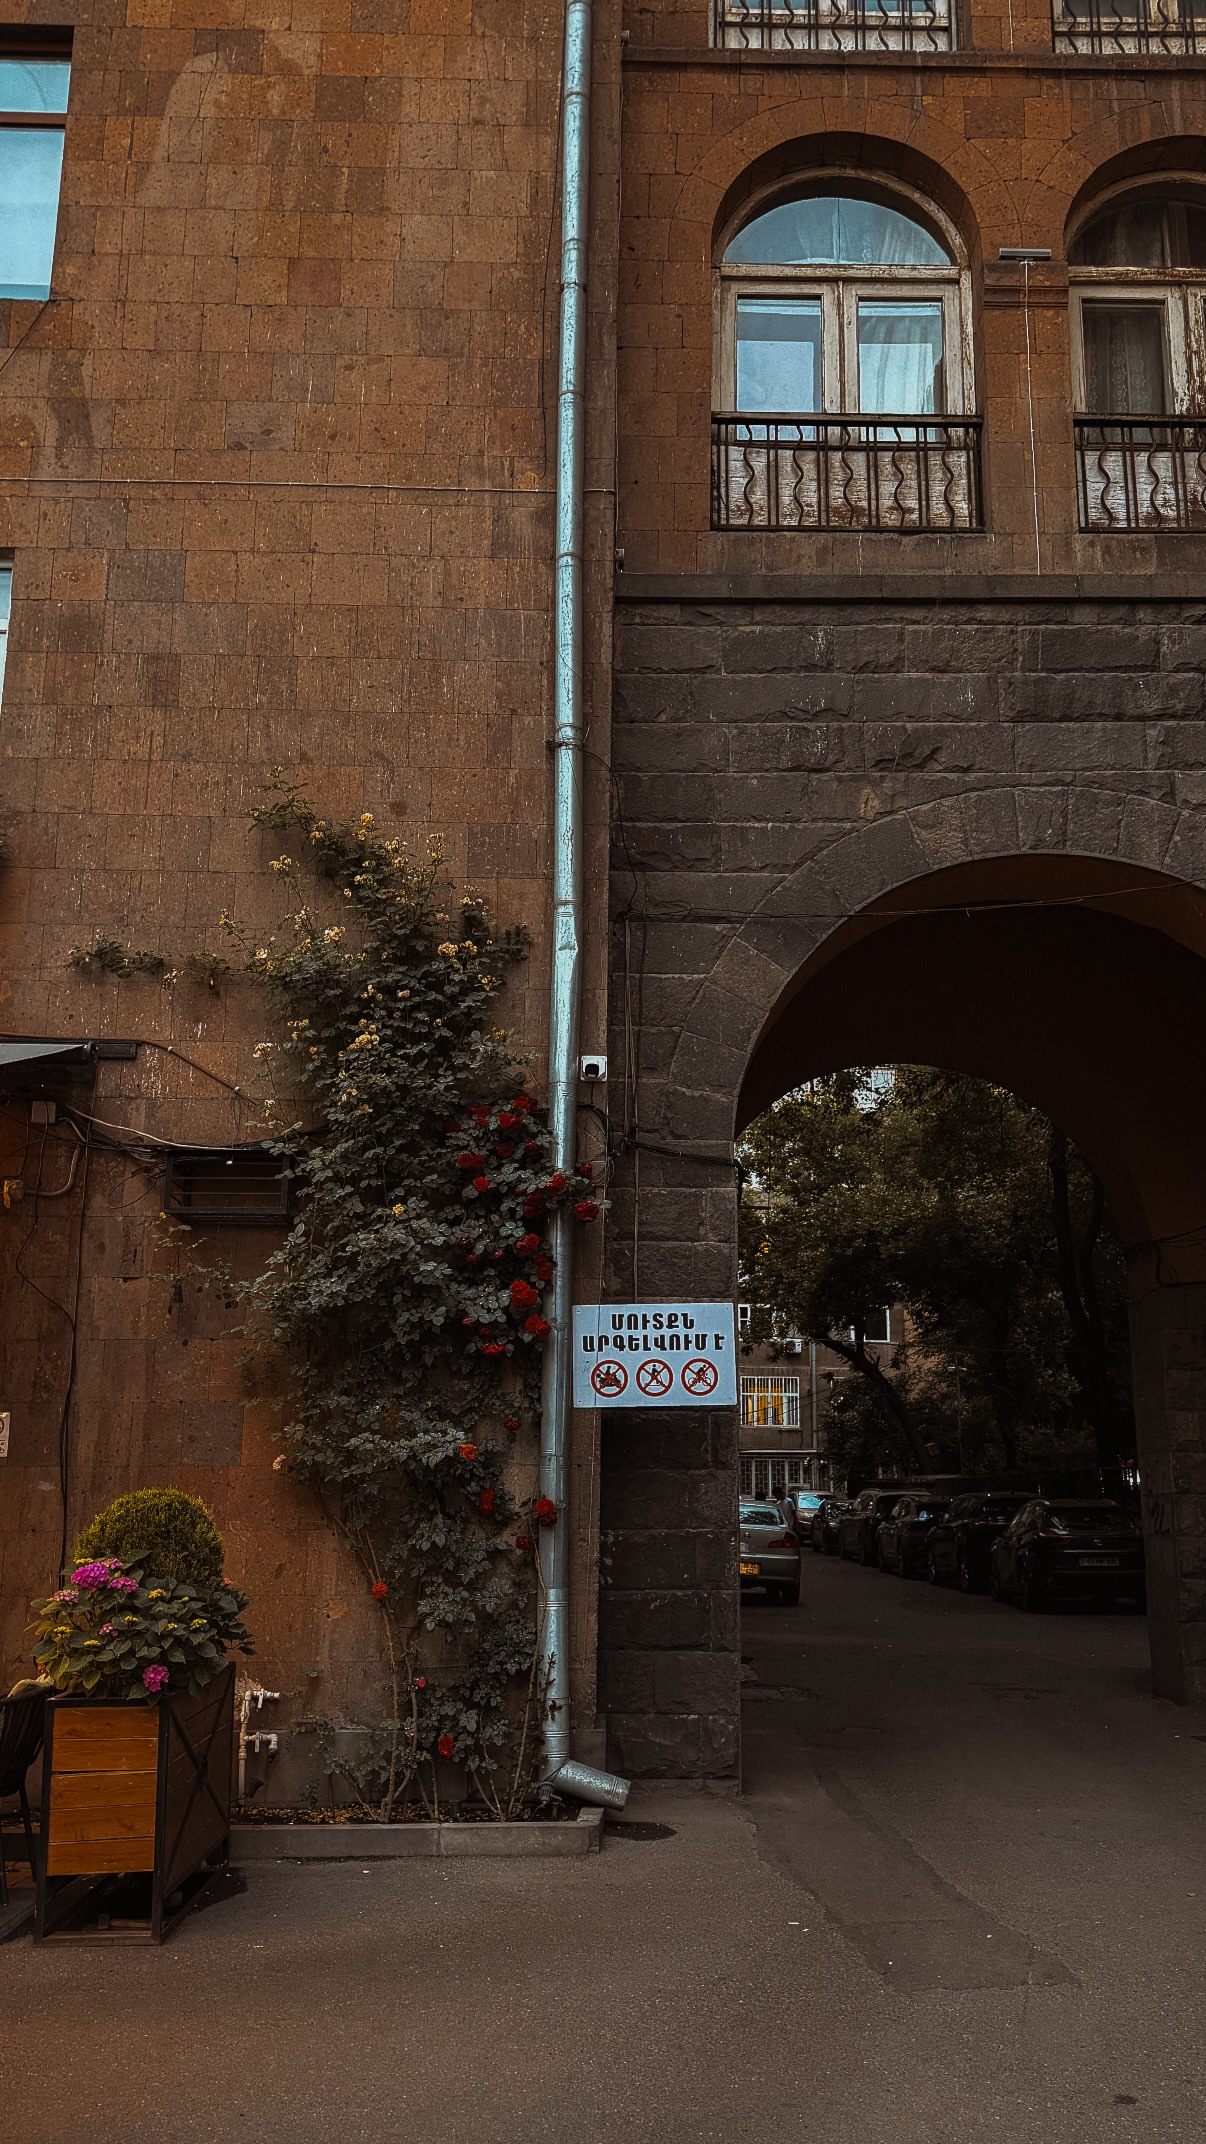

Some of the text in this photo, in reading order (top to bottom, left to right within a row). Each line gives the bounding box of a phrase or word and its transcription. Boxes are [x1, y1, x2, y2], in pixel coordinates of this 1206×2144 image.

[611, 1313, 695, 1330] ՄՈՒՏՔՆ
[582, 1333, 725, 1352] ԱՐԳԵԼՎՈՒՄ Է
